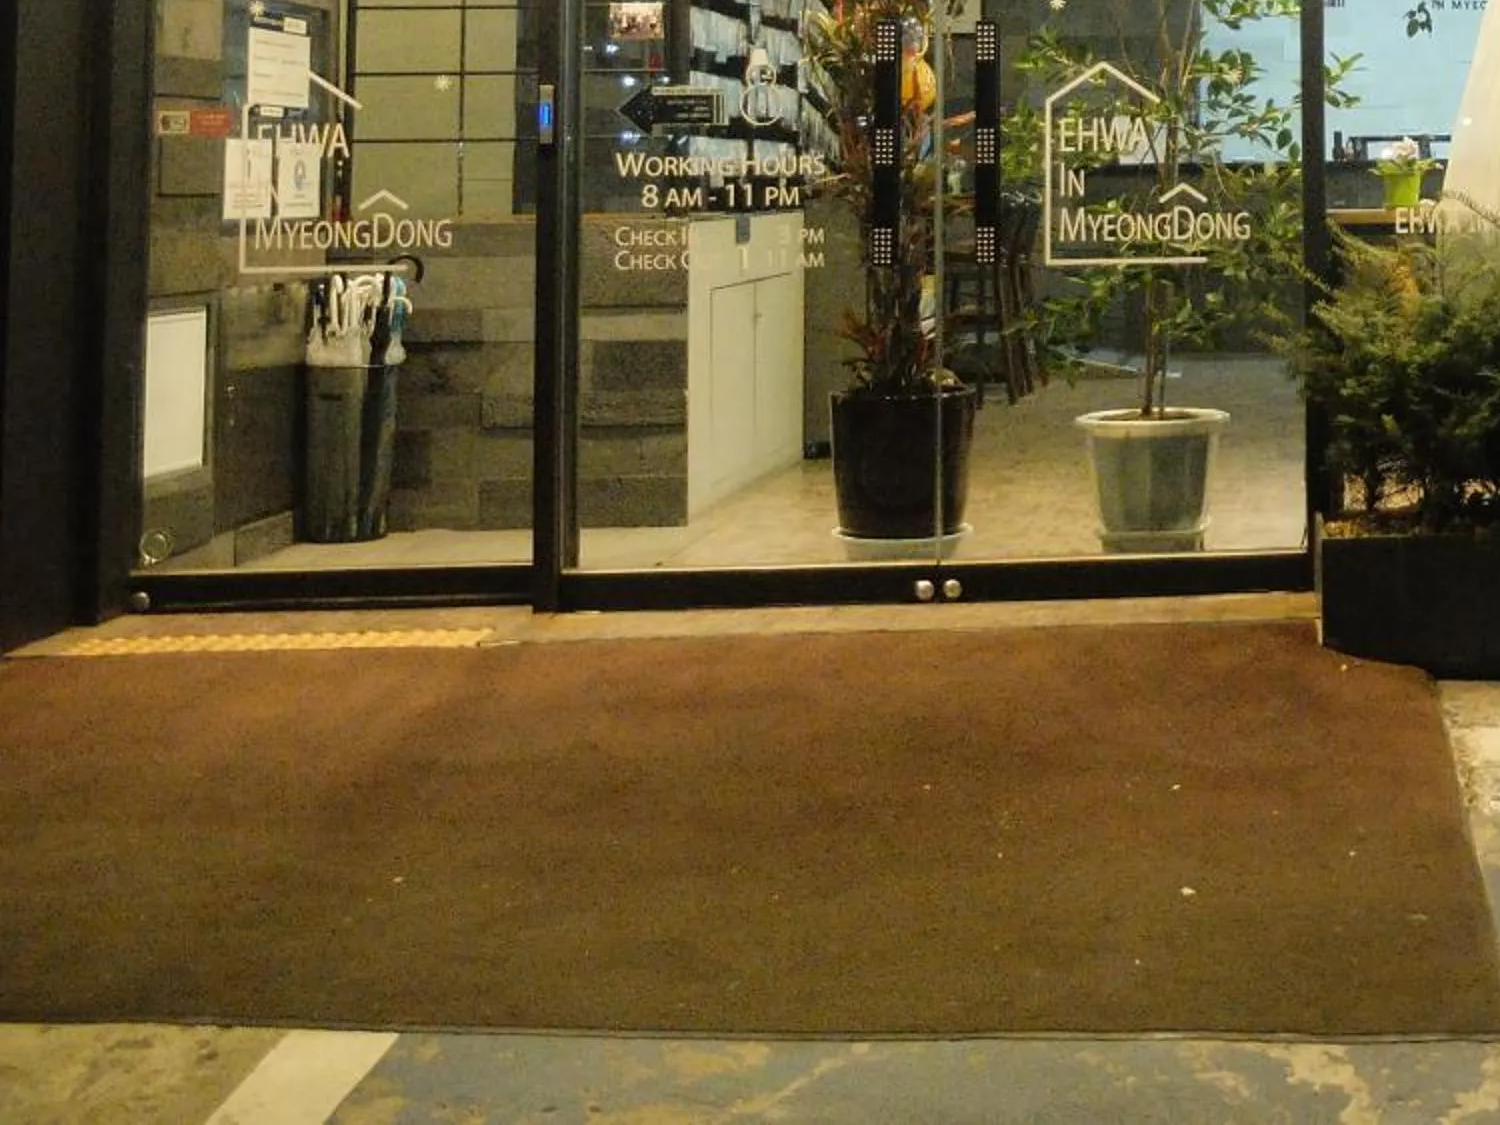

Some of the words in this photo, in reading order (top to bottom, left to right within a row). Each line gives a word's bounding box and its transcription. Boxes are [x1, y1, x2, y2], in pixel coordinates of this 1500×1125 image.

[1058, 116, 1150, 152] EHWA
[615, 151, 738, 177] WORKING
[741, 150, 825, 176] HOURS
[1058, 162, 1085, 197] IN
[641, 184, 658, 208] 8
[664, 188, 702, 207] AM
[725, 183, 752, 207] 11
[765, 186, 800, 206] PM
[255, 212, 453, 251] MYEONGDONG
[615, 227, 677, 247] CHECK
[800, 227, 825, 244] PM
[1058, 205, 1250, 243] MYEONGDONG
[615, 250, 677, 271] CHECK
